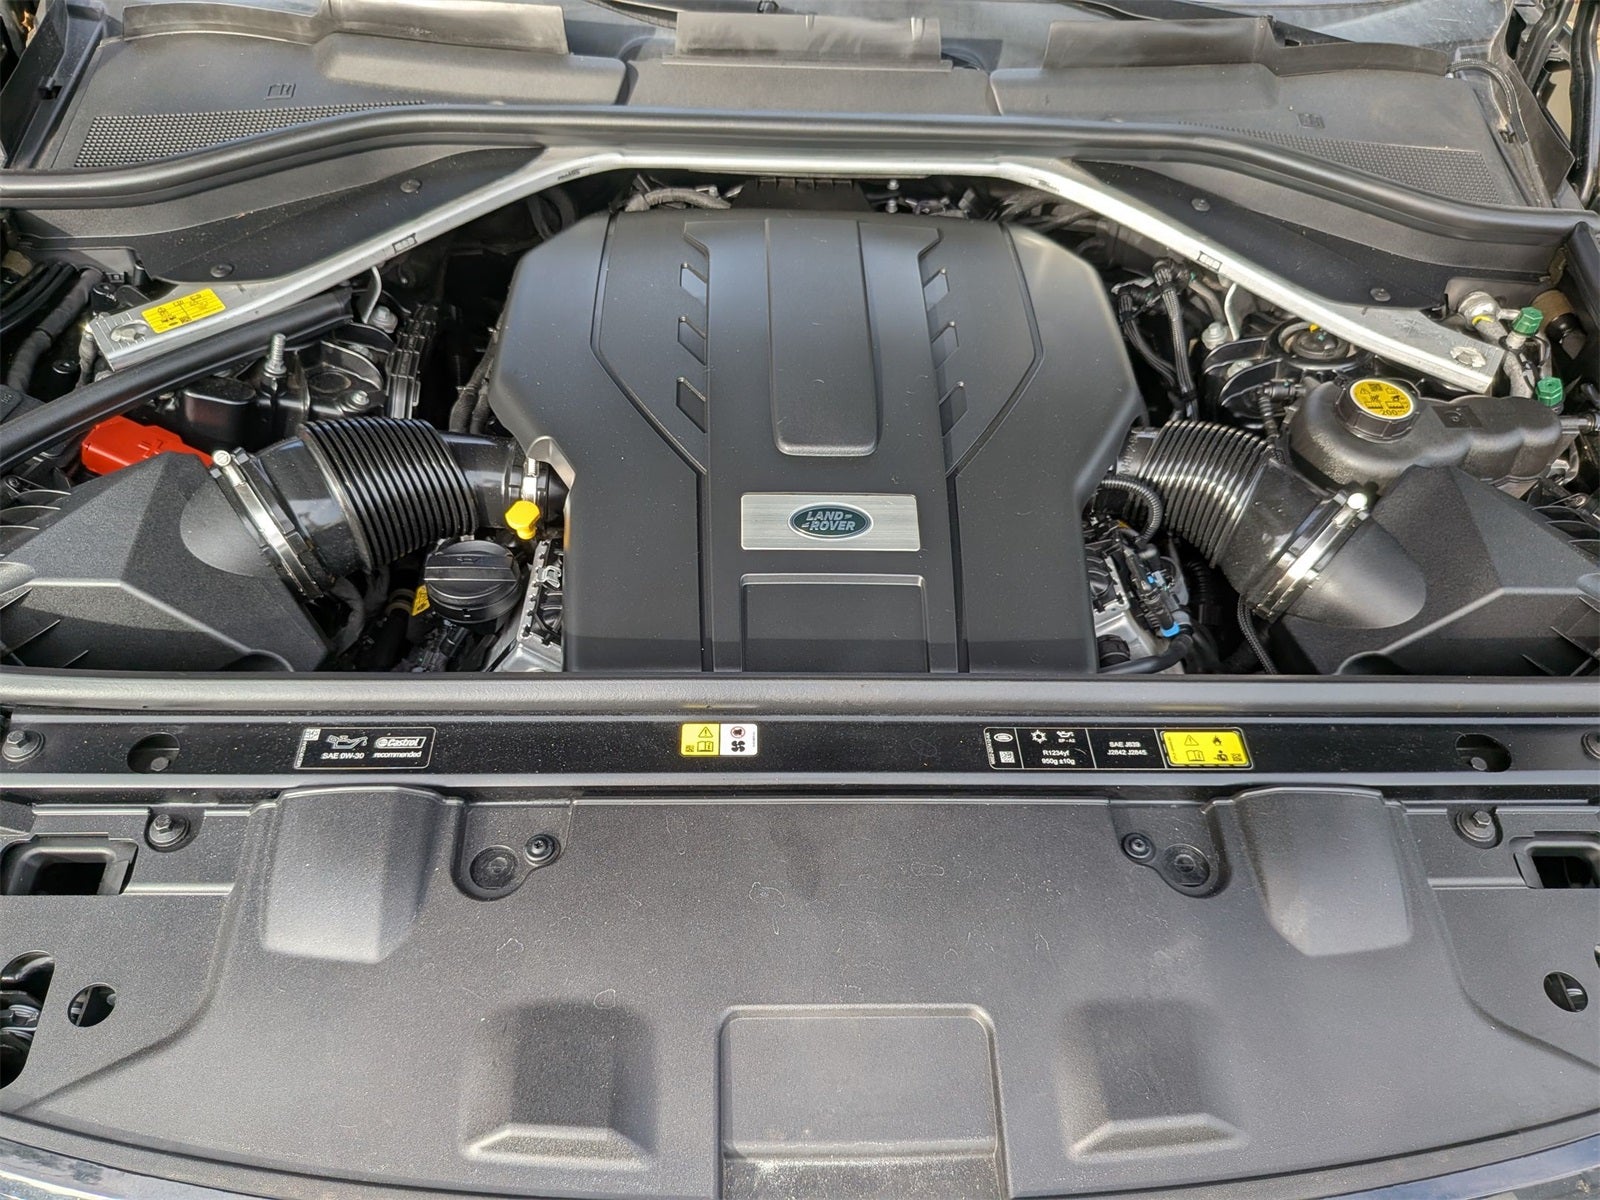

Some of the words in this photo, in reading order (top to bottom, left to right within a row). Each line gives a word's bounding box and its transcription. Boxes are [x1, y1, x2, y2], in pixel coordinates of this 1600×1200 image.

[806, 511, 844, 521] LAND
[809, 520, 856, 531] ROVER
[387, 738, 420, 747] Castrol
[321, 752, 339, 760] SAE
[372, 751, 422, 759] recommended
[1042, 749, 1070, 757] R1234yf
